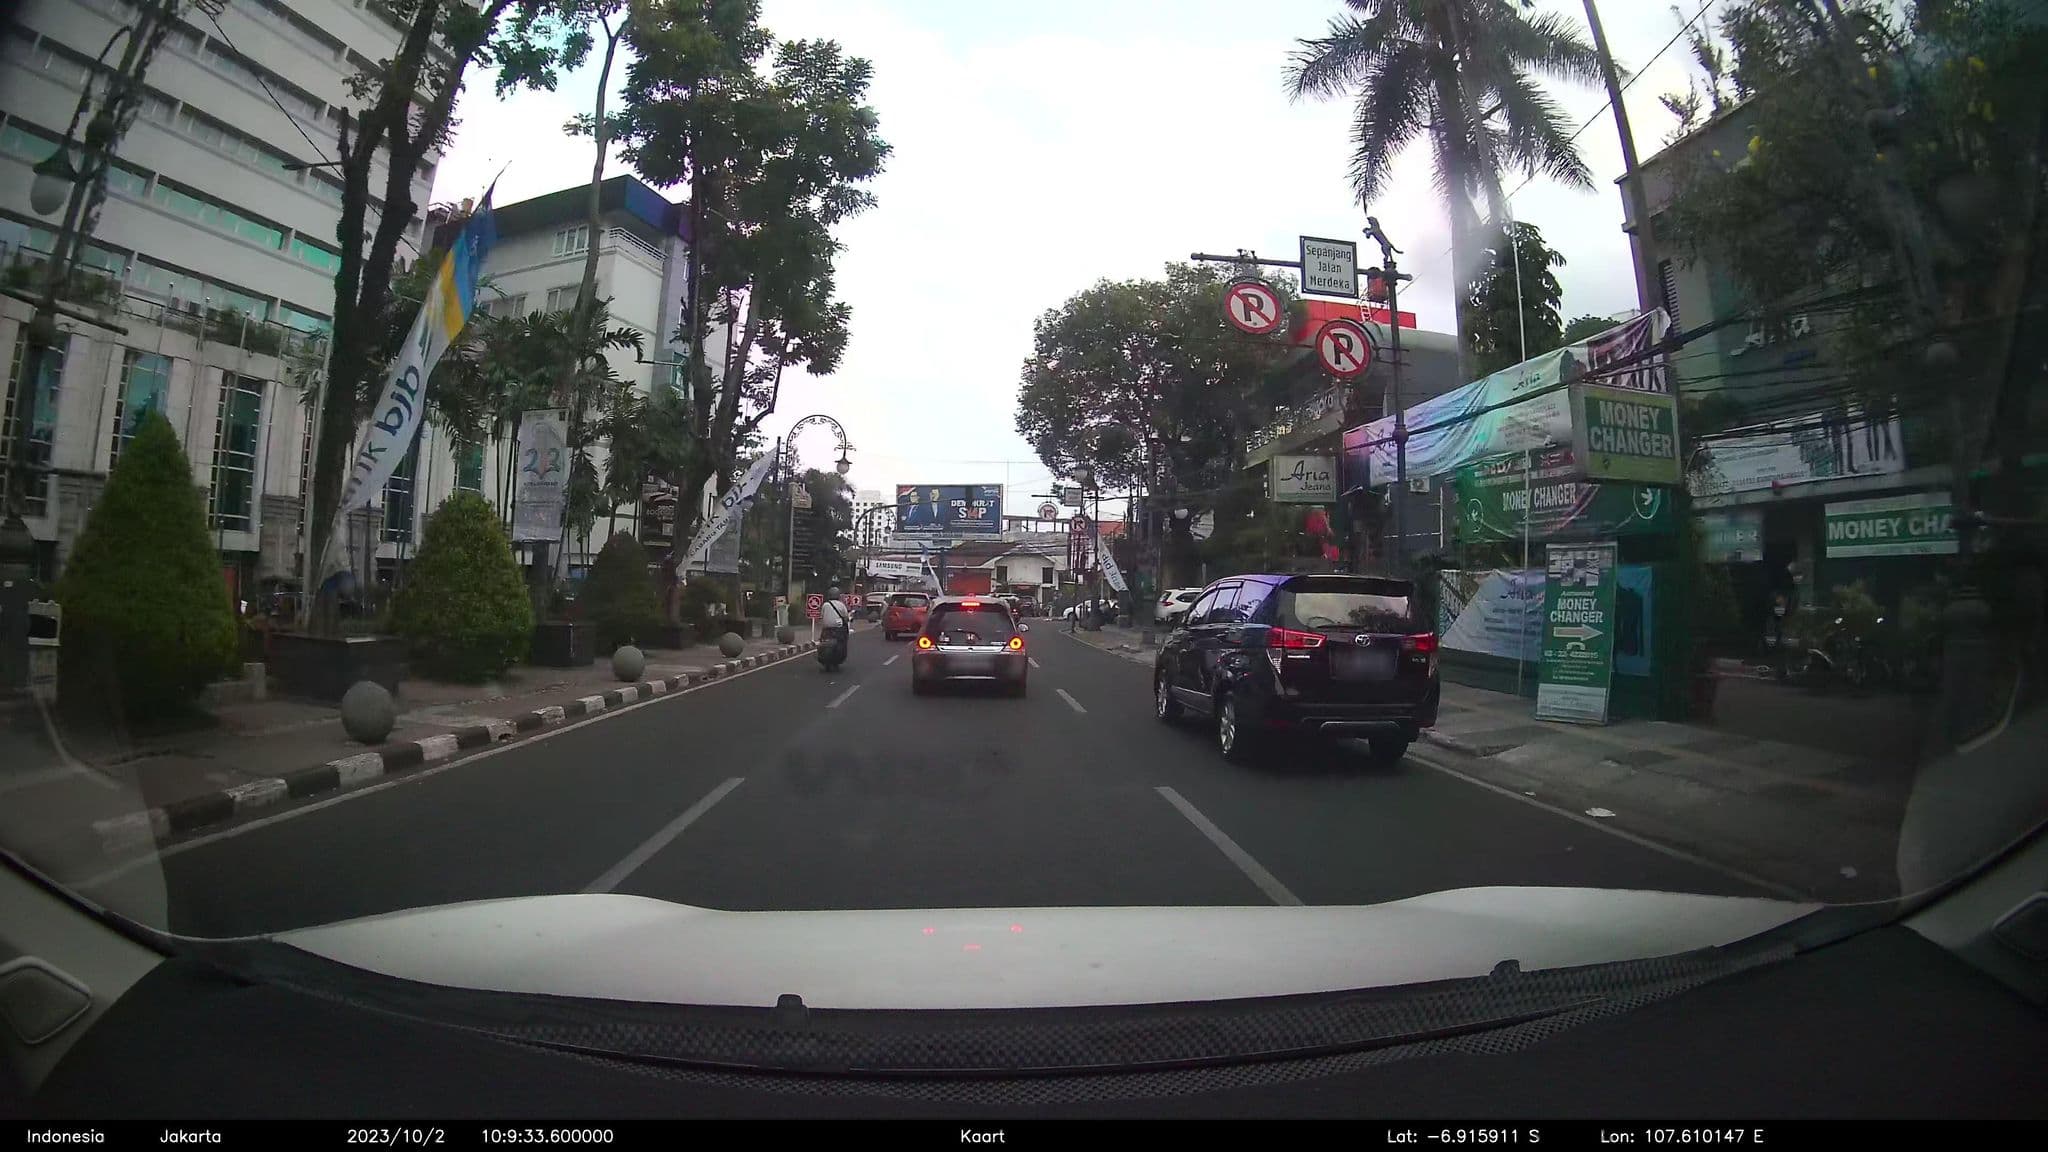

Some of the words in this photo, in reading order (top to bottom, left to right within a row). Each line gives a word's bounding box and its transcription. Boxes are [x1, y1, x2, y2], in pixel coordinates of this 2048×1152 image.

[1306, 245, 1352, 260] Sepanjang
[1318, 262, 1342, 273] Jalan
[1310, 276, 1350, 290] Merdeka
[375, 365, 419, 436] bjb
[1599, 400, 1660, 431] MONEY
[1590, 426, 1673, 458] CHANGER
[1281, 460, 1329, 481] Aria
[1501, 488, 1532, 512] MONEY
[1534, 482, 1577, 508] CHANGER
[1828, 517, 1902, 540] MONEY
[876, 562, 903, 570] SAMSUNG
[1558, 598, 1597, 611] MONEY
[1550, 611, 1604, 623] CHANGER
